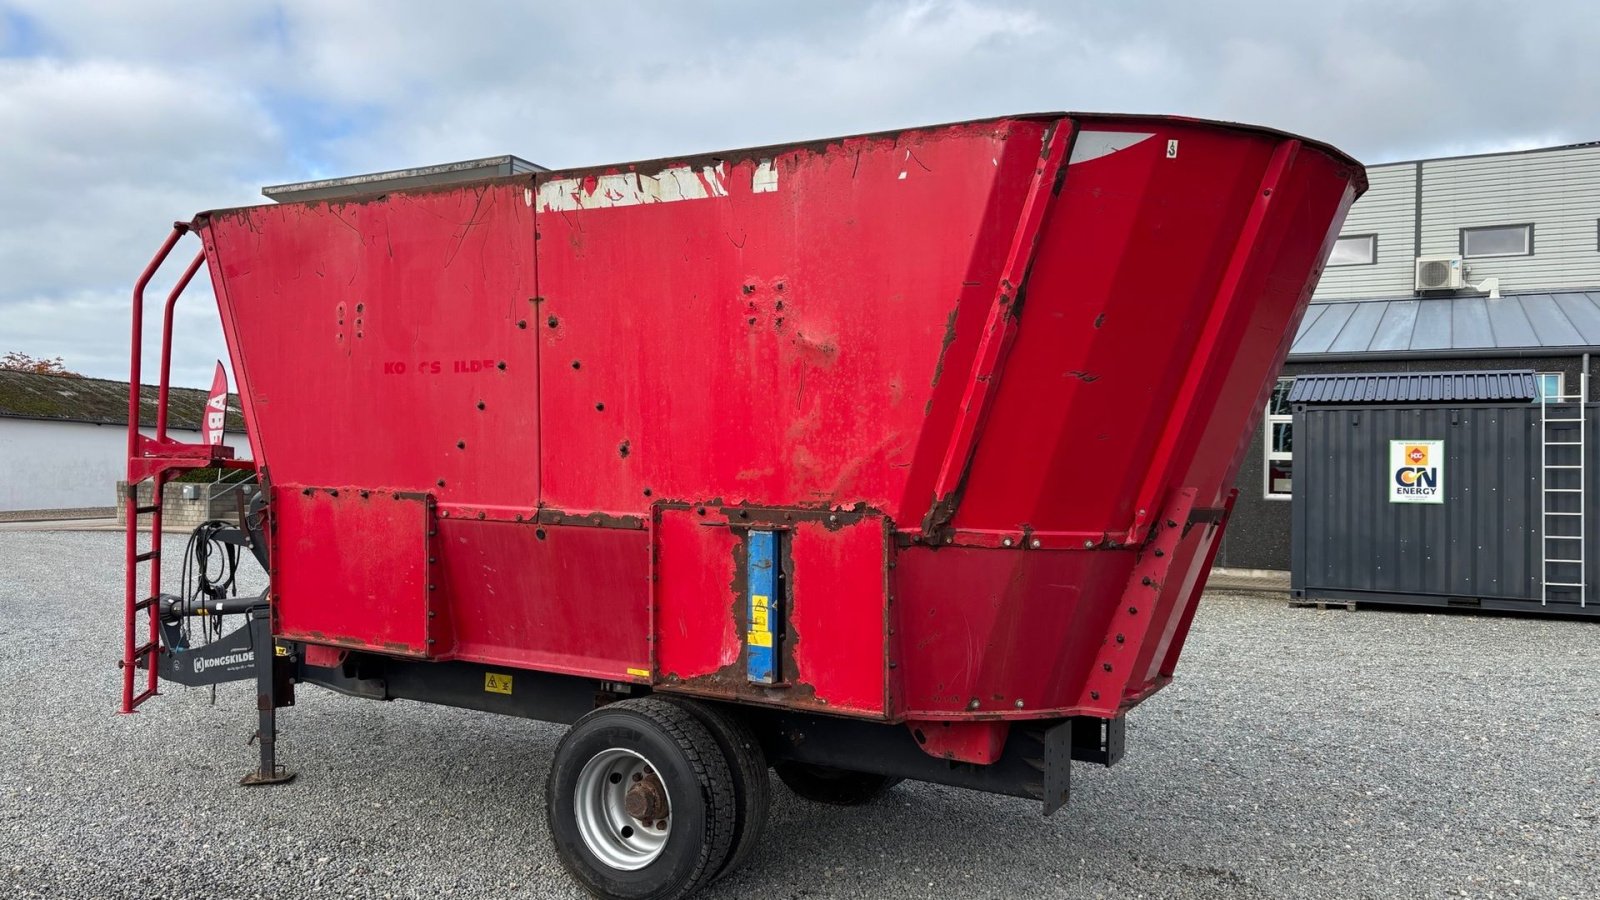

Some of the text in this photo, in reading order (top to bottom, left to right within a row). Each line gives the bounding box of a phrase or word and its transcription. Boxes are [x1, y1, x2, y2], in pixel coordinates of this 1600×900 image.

[1395, 467, 1437, 487] CN
[1397, 487, 1437, 495] ENERGY
[204, 651, 255, 669] KONGSKILDE
